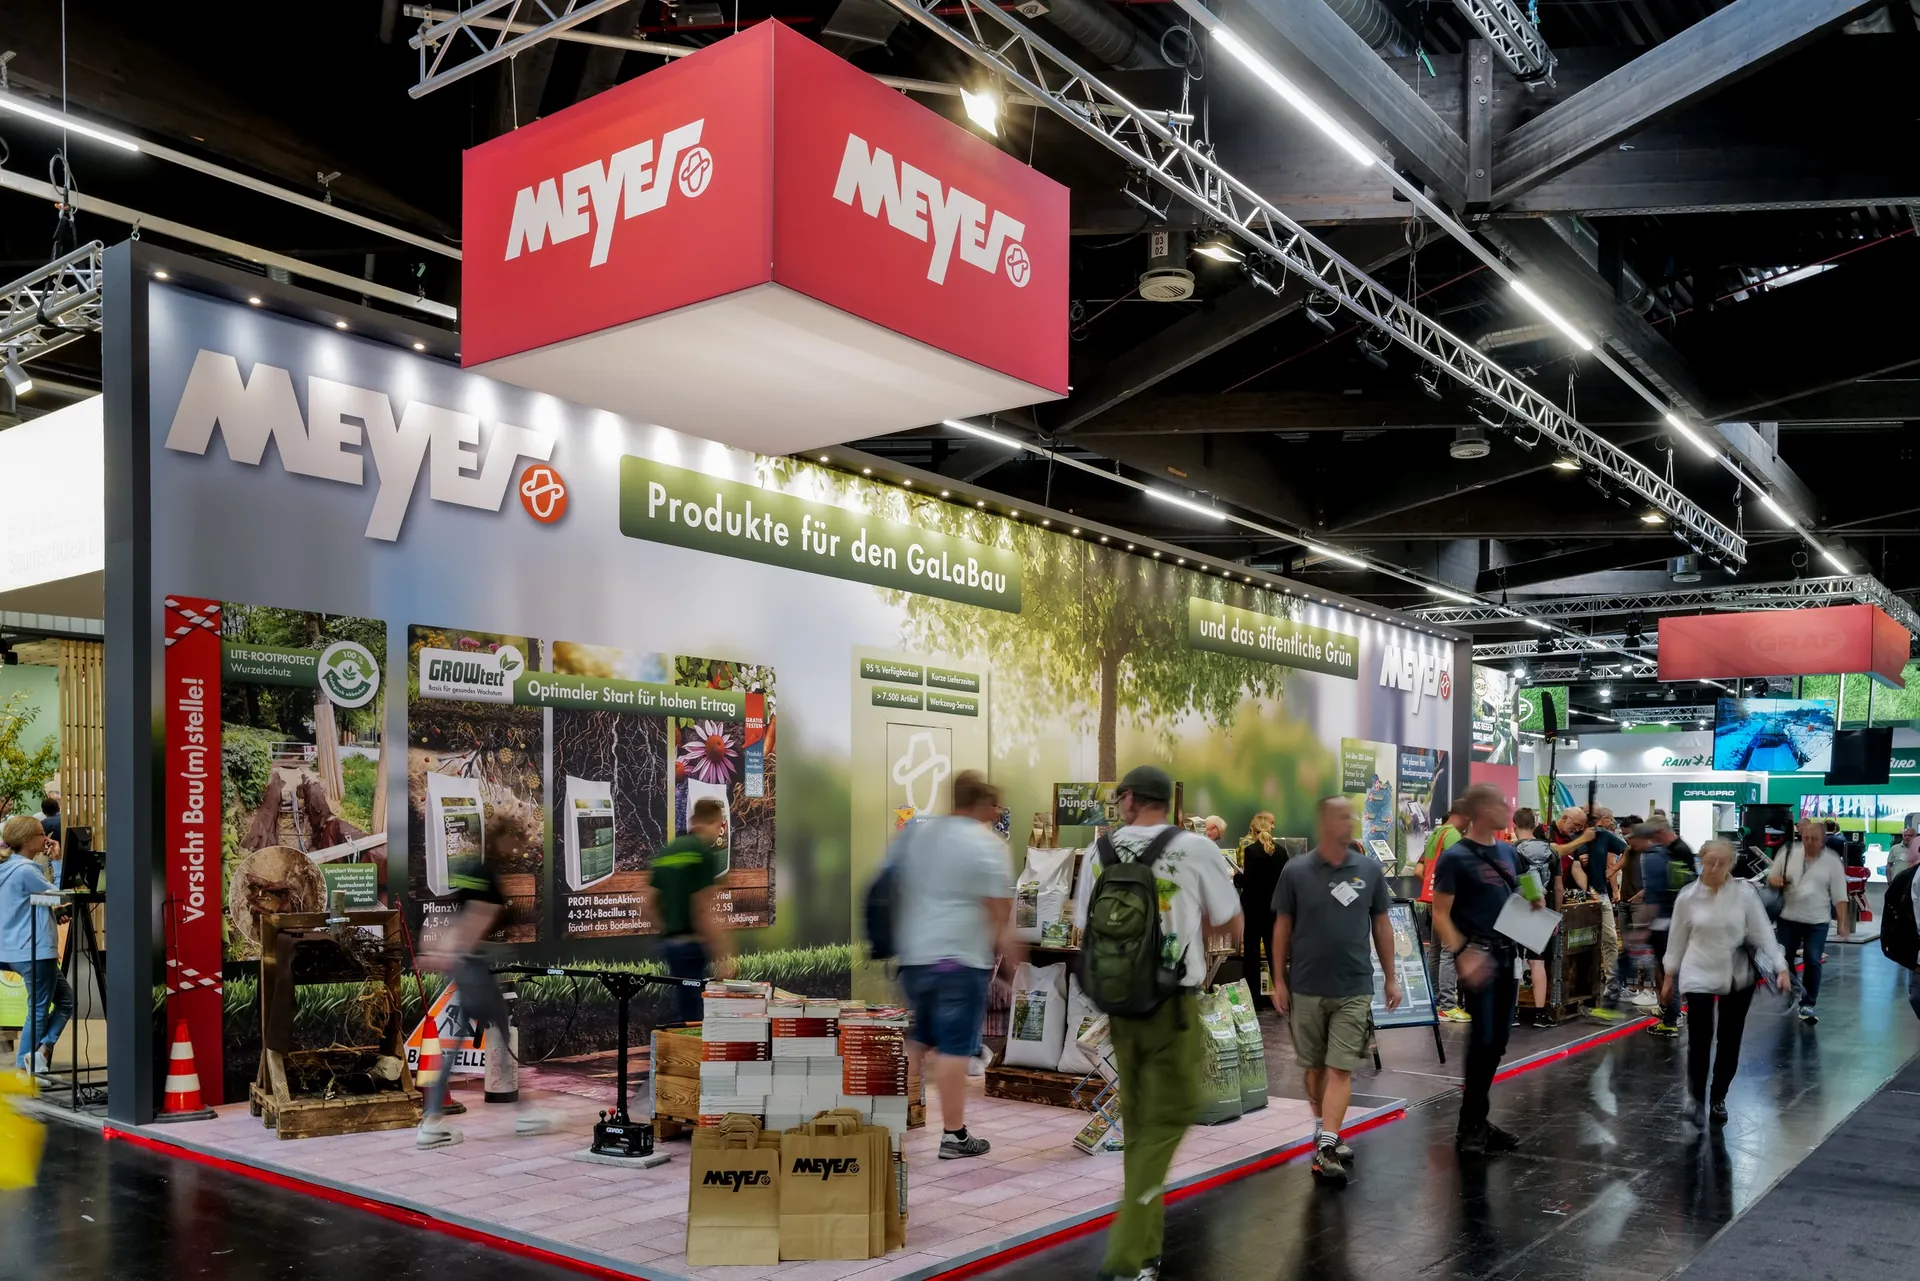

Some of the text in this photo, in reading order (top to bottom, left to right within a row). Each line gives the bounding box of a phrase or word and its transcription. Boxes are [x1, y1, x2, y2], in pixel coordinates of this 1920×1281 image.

[505, 118, 704, 268] MEYER
[833, 132, 1025, 286] MEYER
[165, 348, 556, 542] MEYER
[647, 481, 1006, 594] Produkte für den GaLaBau
[1200, 614, 1352, 667] und das öffentliche Grün
[1758, 631, 1840, 652] GRAF
[230, 649, 316, 666] LITE-ROOTPROTECT
[342, 651, 357, 659] 100
[230, 663, 291, 677] Wurzelschutz
[428, 659, 505, 687] GROWtect
[866, 663, 919, 678] 95 % Verfügbarkeit
[931, 672, 976, 686] Kurze Lieferzeiten
[1379, 644, 1450, 715] MEYER
[428, 684, 503, 697] Basis für gesundes Wachstum
[528, 680, 736, 717] Optimaler Start für hohen Ertrag
[882, 692, 900, 702] 7.500
[900, 694, 919, 704] Artikel
[930, 697, 975, 711] Werkzeug-Service
[1662, 756, 1692, 767] RAIN
[179, 678, 208, 924] Vorsicht Bau(m)stelle!
[1059, 797, 1099, 811] Dünger
[568, 896, 592, 906] PROFI
[568, 920, 652, 933] fördert das Bodenleben
[728, 913, 760, 924] Volldünger
[423, 933, 437, 942] mit
[408, 1049, 485, 1067] BELLE
[791, 1157, 858, 1181] MEYER
[702, 1170, 769, 1192] MEYER
